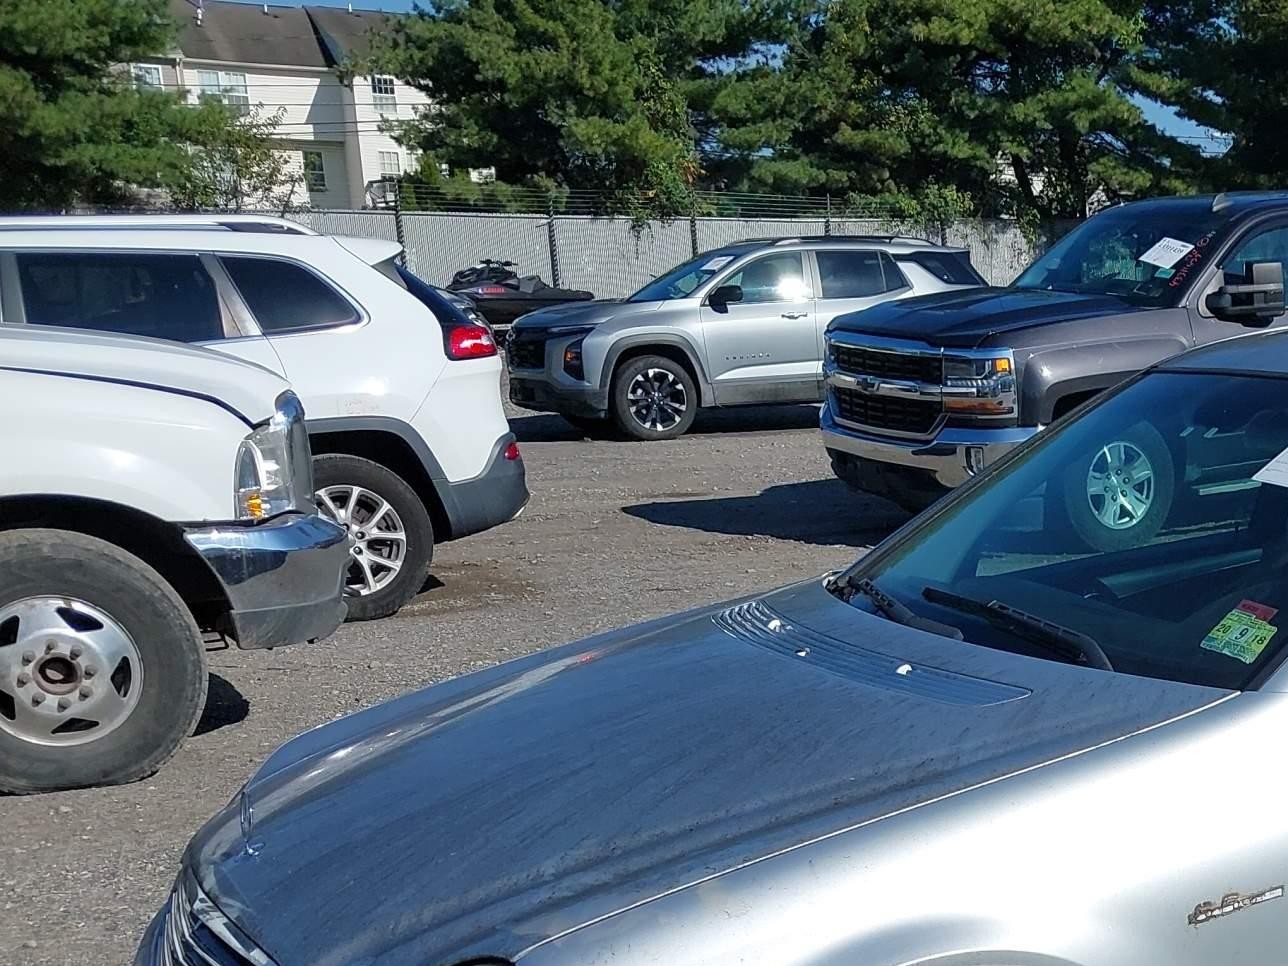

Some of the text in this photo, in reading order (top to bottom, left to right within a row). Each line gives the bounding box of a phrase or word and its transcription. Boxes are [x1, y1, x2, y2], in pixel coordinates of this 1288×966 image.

[1215, 623, 1267, 645] 20 9 18
